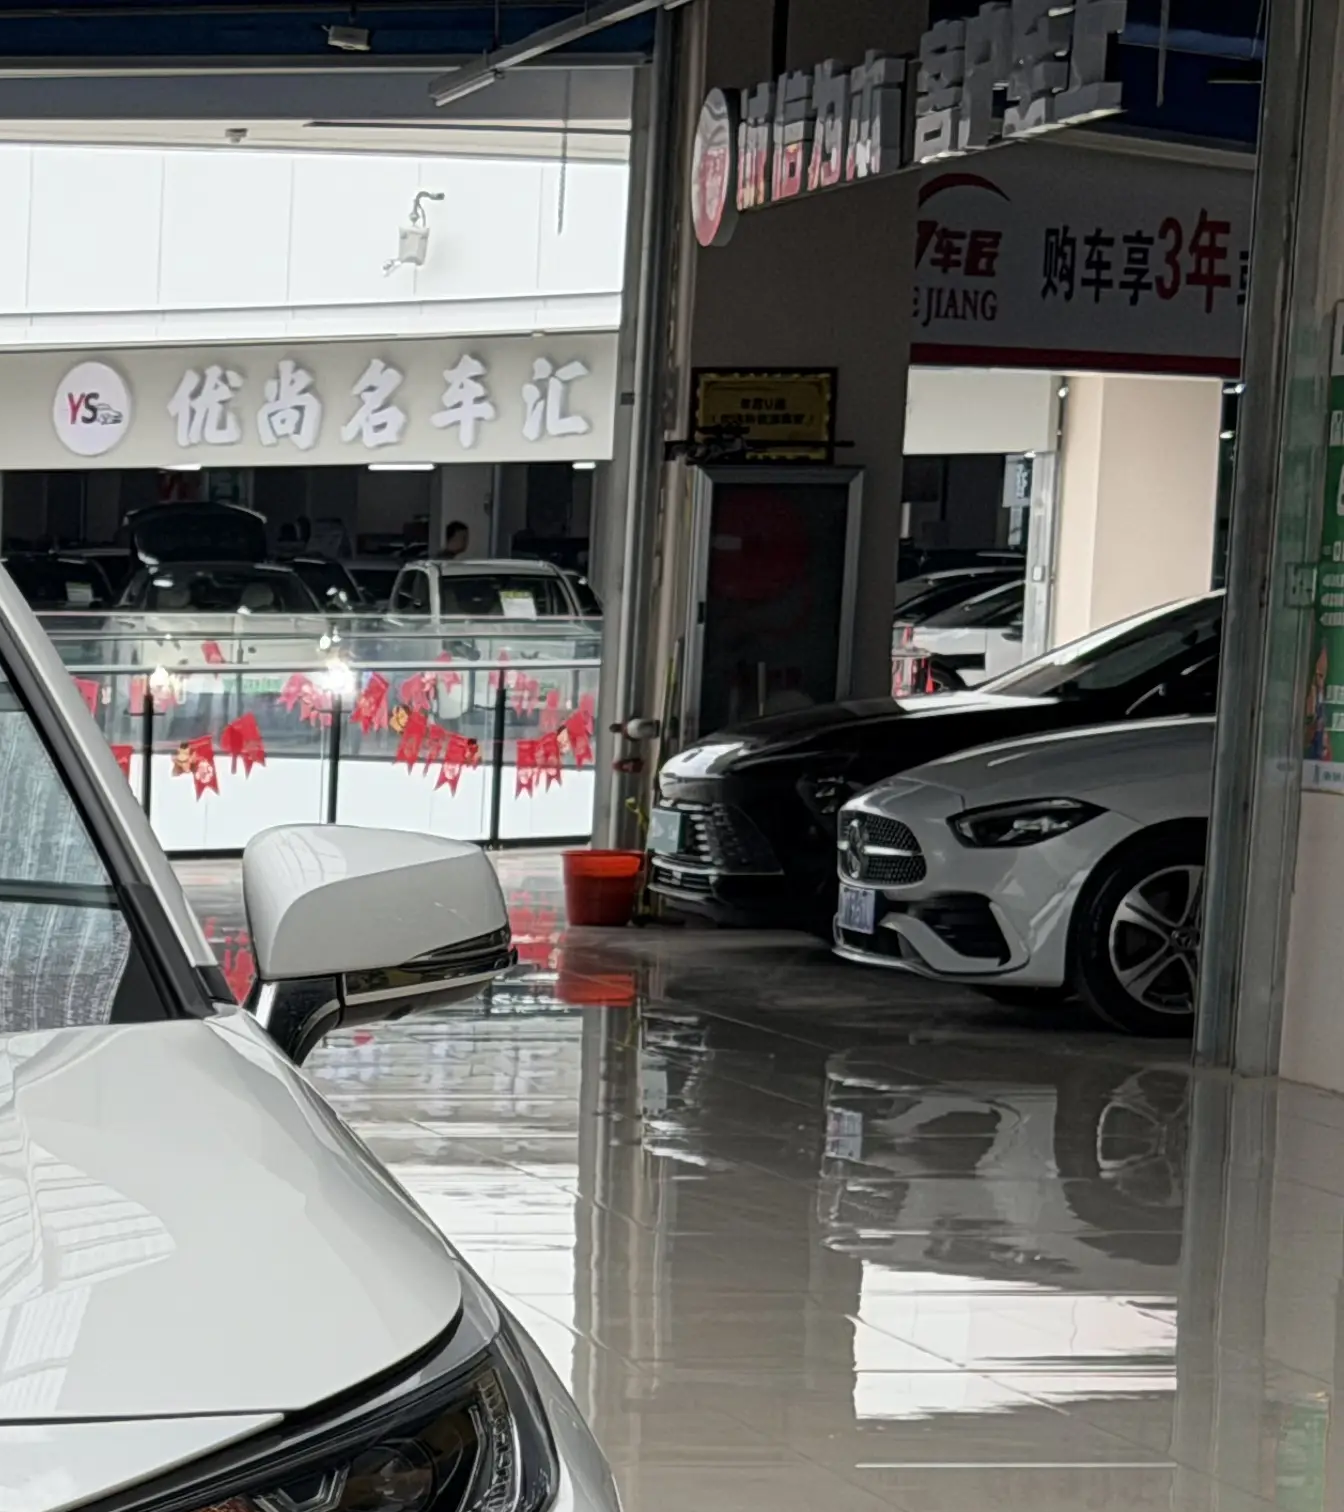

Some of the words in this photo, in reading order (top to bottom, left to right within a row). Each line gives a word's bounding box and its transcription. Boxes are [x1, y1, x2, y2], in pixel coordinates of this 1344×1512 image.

[921, 287, 998, 328] JIANG
[68, 392, 100, 424] YS
[168, 353, 589, 450] 优尚名车汇
